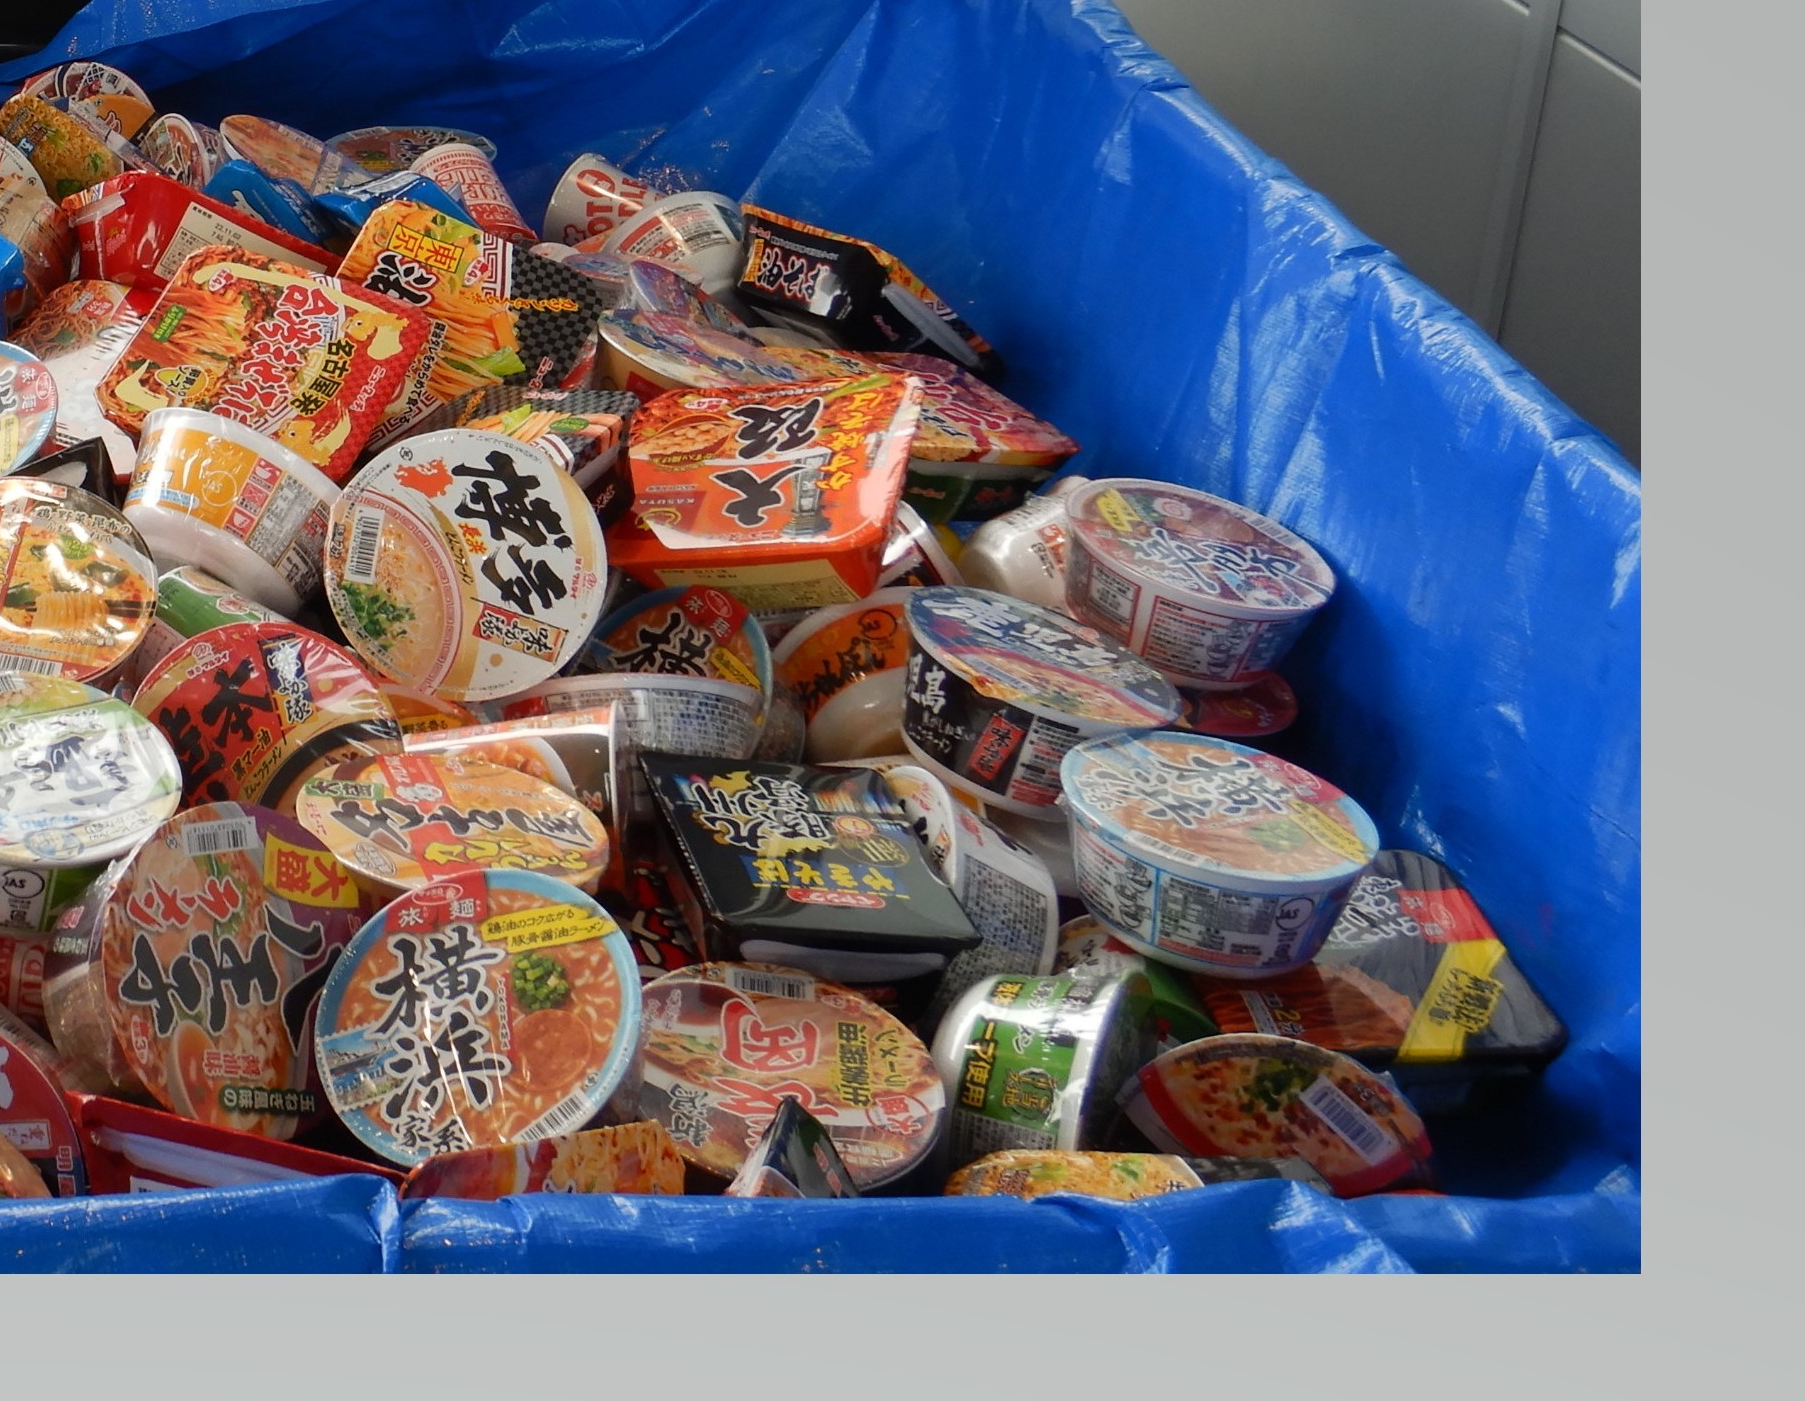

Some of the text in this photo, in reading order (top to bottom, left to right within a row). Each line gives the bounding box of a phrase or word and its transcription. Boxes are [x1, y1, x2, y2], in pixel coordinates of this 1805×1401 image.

[390, 226, 464, 274] 東京
[290, 338, 356, 416] 名古屋発
[703, 398, 824, 528] 大阪
[451, 450, 573, 614] 博多
[460, 522, 487, 554] 長浜
[479, 610, 558, 662] 味よか隊
[187, 651, 230, 679] 味のマルタイ
[266, 642, 313, 723] 味よか隊
[230, 729, 273, 782] 黒マー油
[308, 780, 379, 799] 大盛
[329, 801, 594, 850] 名古屋
[273, 847, 351, 901] 大盛
[756, 857, 896, 893] やきそば
[807, 890, 880, 908] ペヤング
[127, 876, 242, 933] ラーメン
[486, 908, 576, 936] 鶏油のコク広がる
[510, 919, 608, 948] 豚骨醤油ラーメン
[119, 903, 343, 1057] 八王子
[372, 924, 510, 1119] 横浜
[495, 977, 512, 1051] YOKOHAMA
[203, 1048, 262, 1079] 醤油味
[837, 1020, 871, 1107] 生姜醤油
[874, 1029, 904, 1088] ラーメン
[222, 1085, 317, 1115] 玉ねぎ風味の
[668, 1084, 711, 1149] 新潟
[872, 1093, 926, 1135] 大盛
[395, 1110, 468, 1156] 家系
